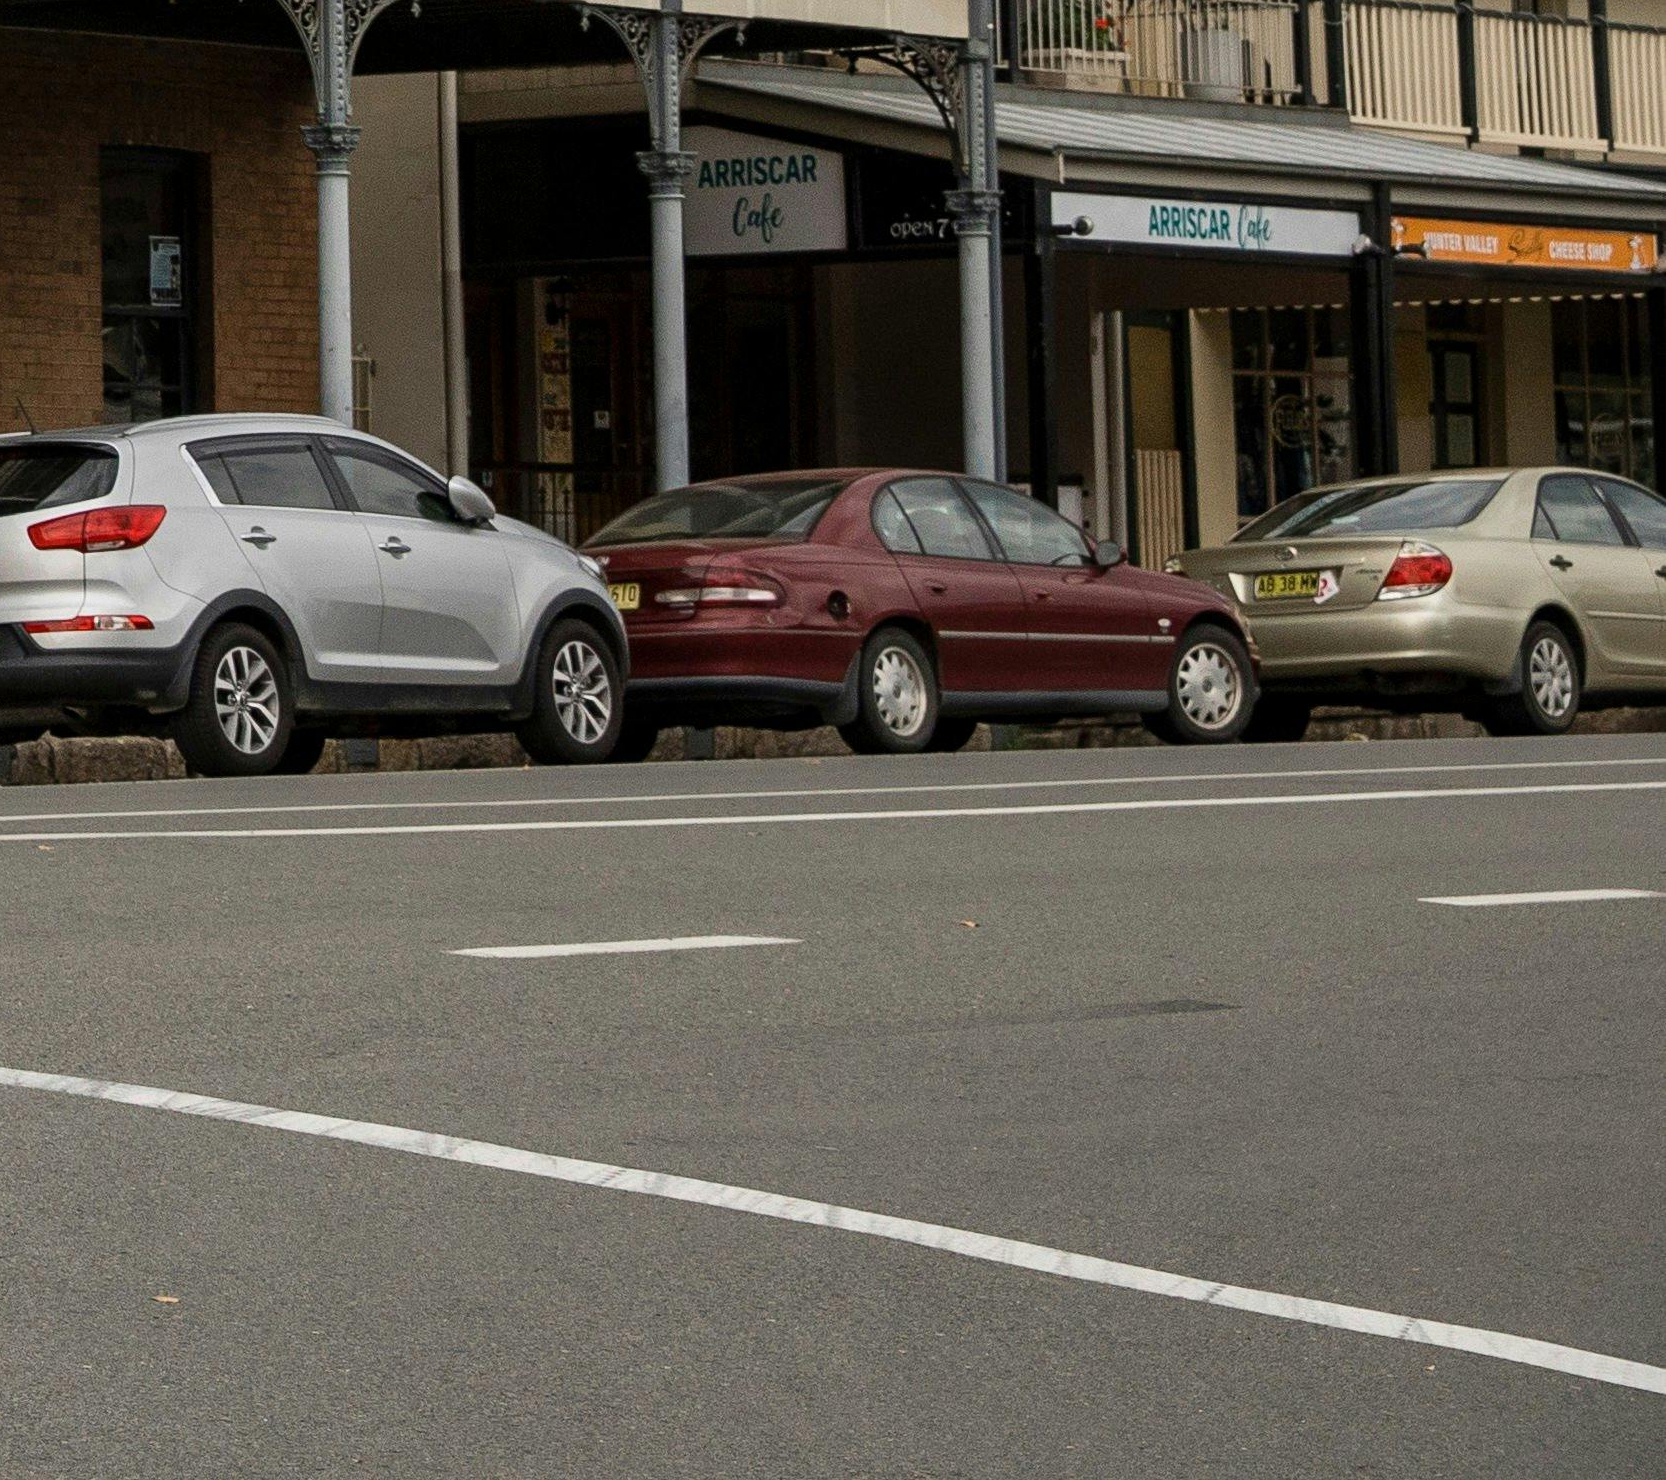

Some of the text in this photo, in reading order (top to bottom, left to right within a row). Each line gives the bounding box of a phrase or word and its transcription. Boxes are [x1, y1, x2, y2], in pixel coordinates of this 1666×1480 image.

[697, 153, 818, 189] ARRISCAR
[731, 192, 785, 244] Cafe
[936, 218, 950, 239] 7
[1148, 203, 1273, 250] ARRISCAR Cafe
[1464, 235, 1500, 256] VALLEY
[1548, 239, 1585, 261] CHEESE
[1586, 242, 1614, 262] SHOP
[1279, 575, 1296, 592] 38
